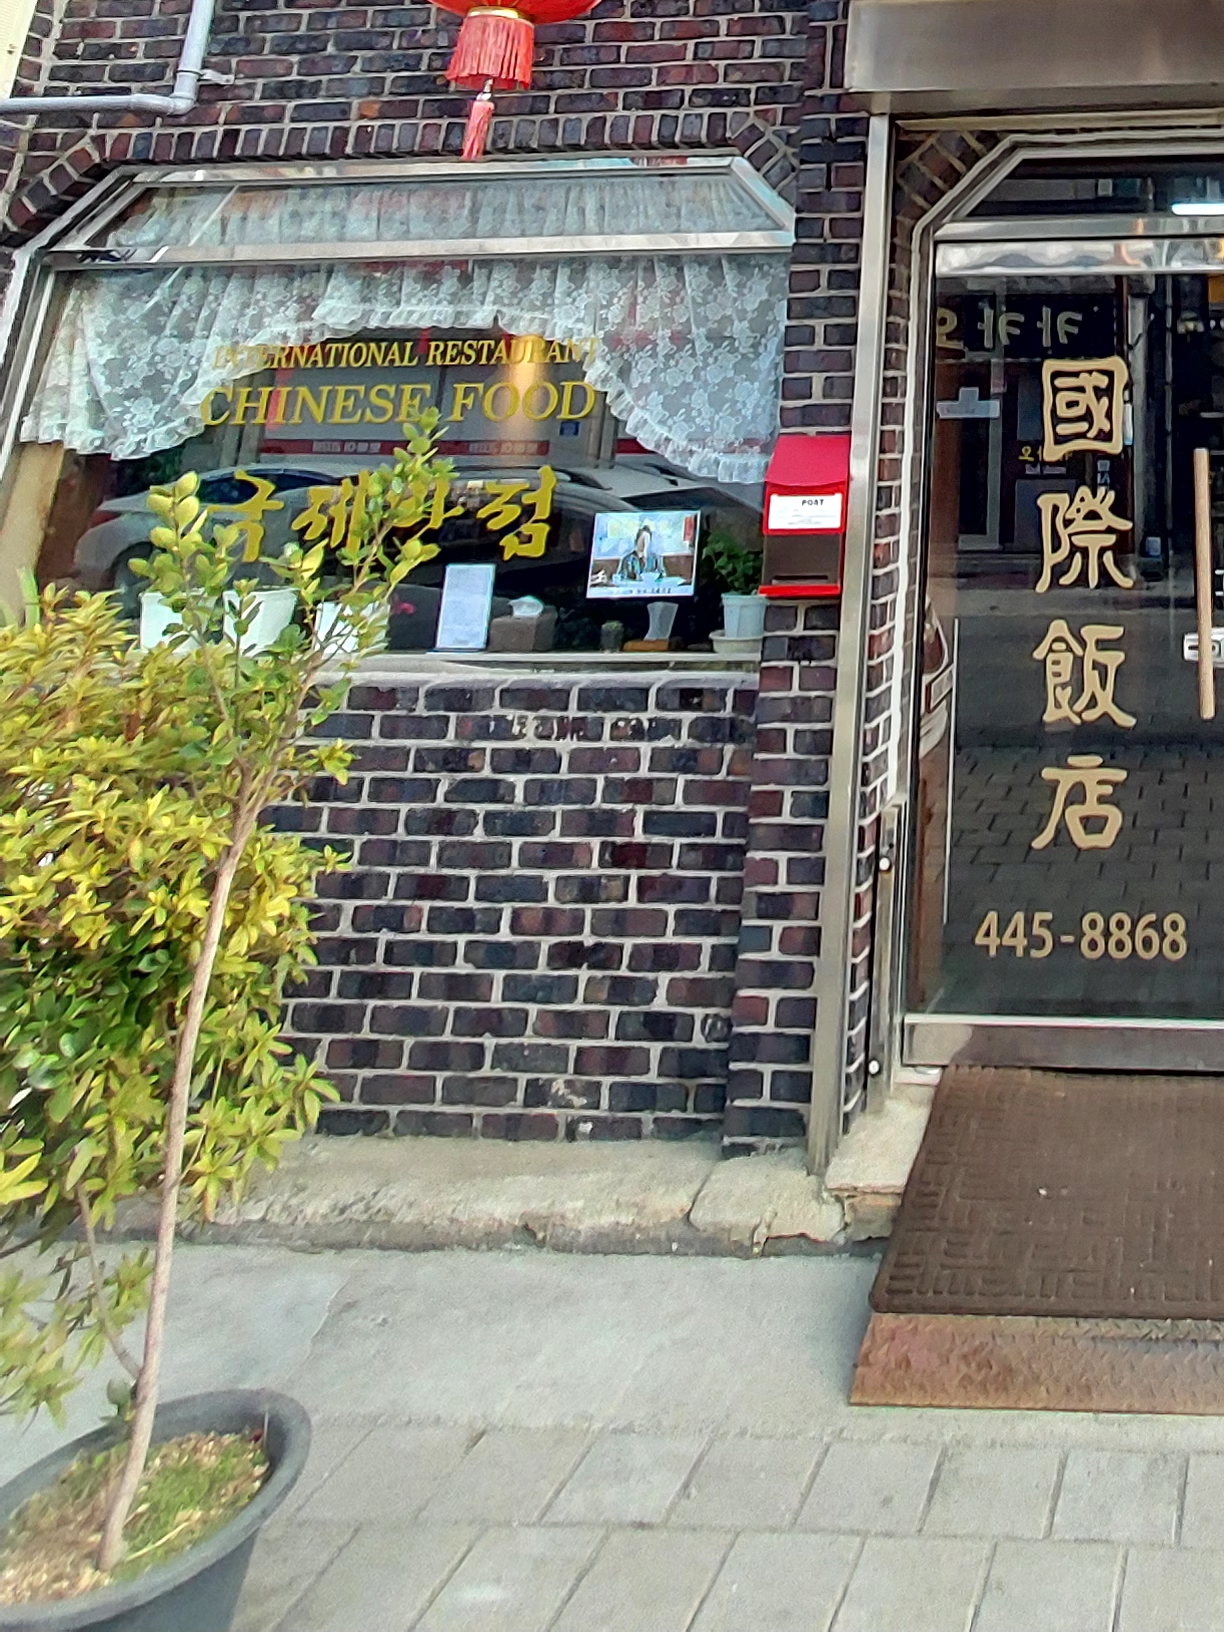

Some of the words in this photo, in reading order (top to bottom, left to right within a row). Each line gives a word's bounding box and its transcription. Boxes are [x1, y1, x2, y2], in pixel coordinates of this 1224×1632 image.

[212, 340, 419, 370] INTERNATIONAL
[200, 382, 432, 427] CHINESE
[446, 380, 596, 423] FOOD
[1031, 355, 1138, 851] 國際飯店
[975, 910, 1189, 961] 445-8868
